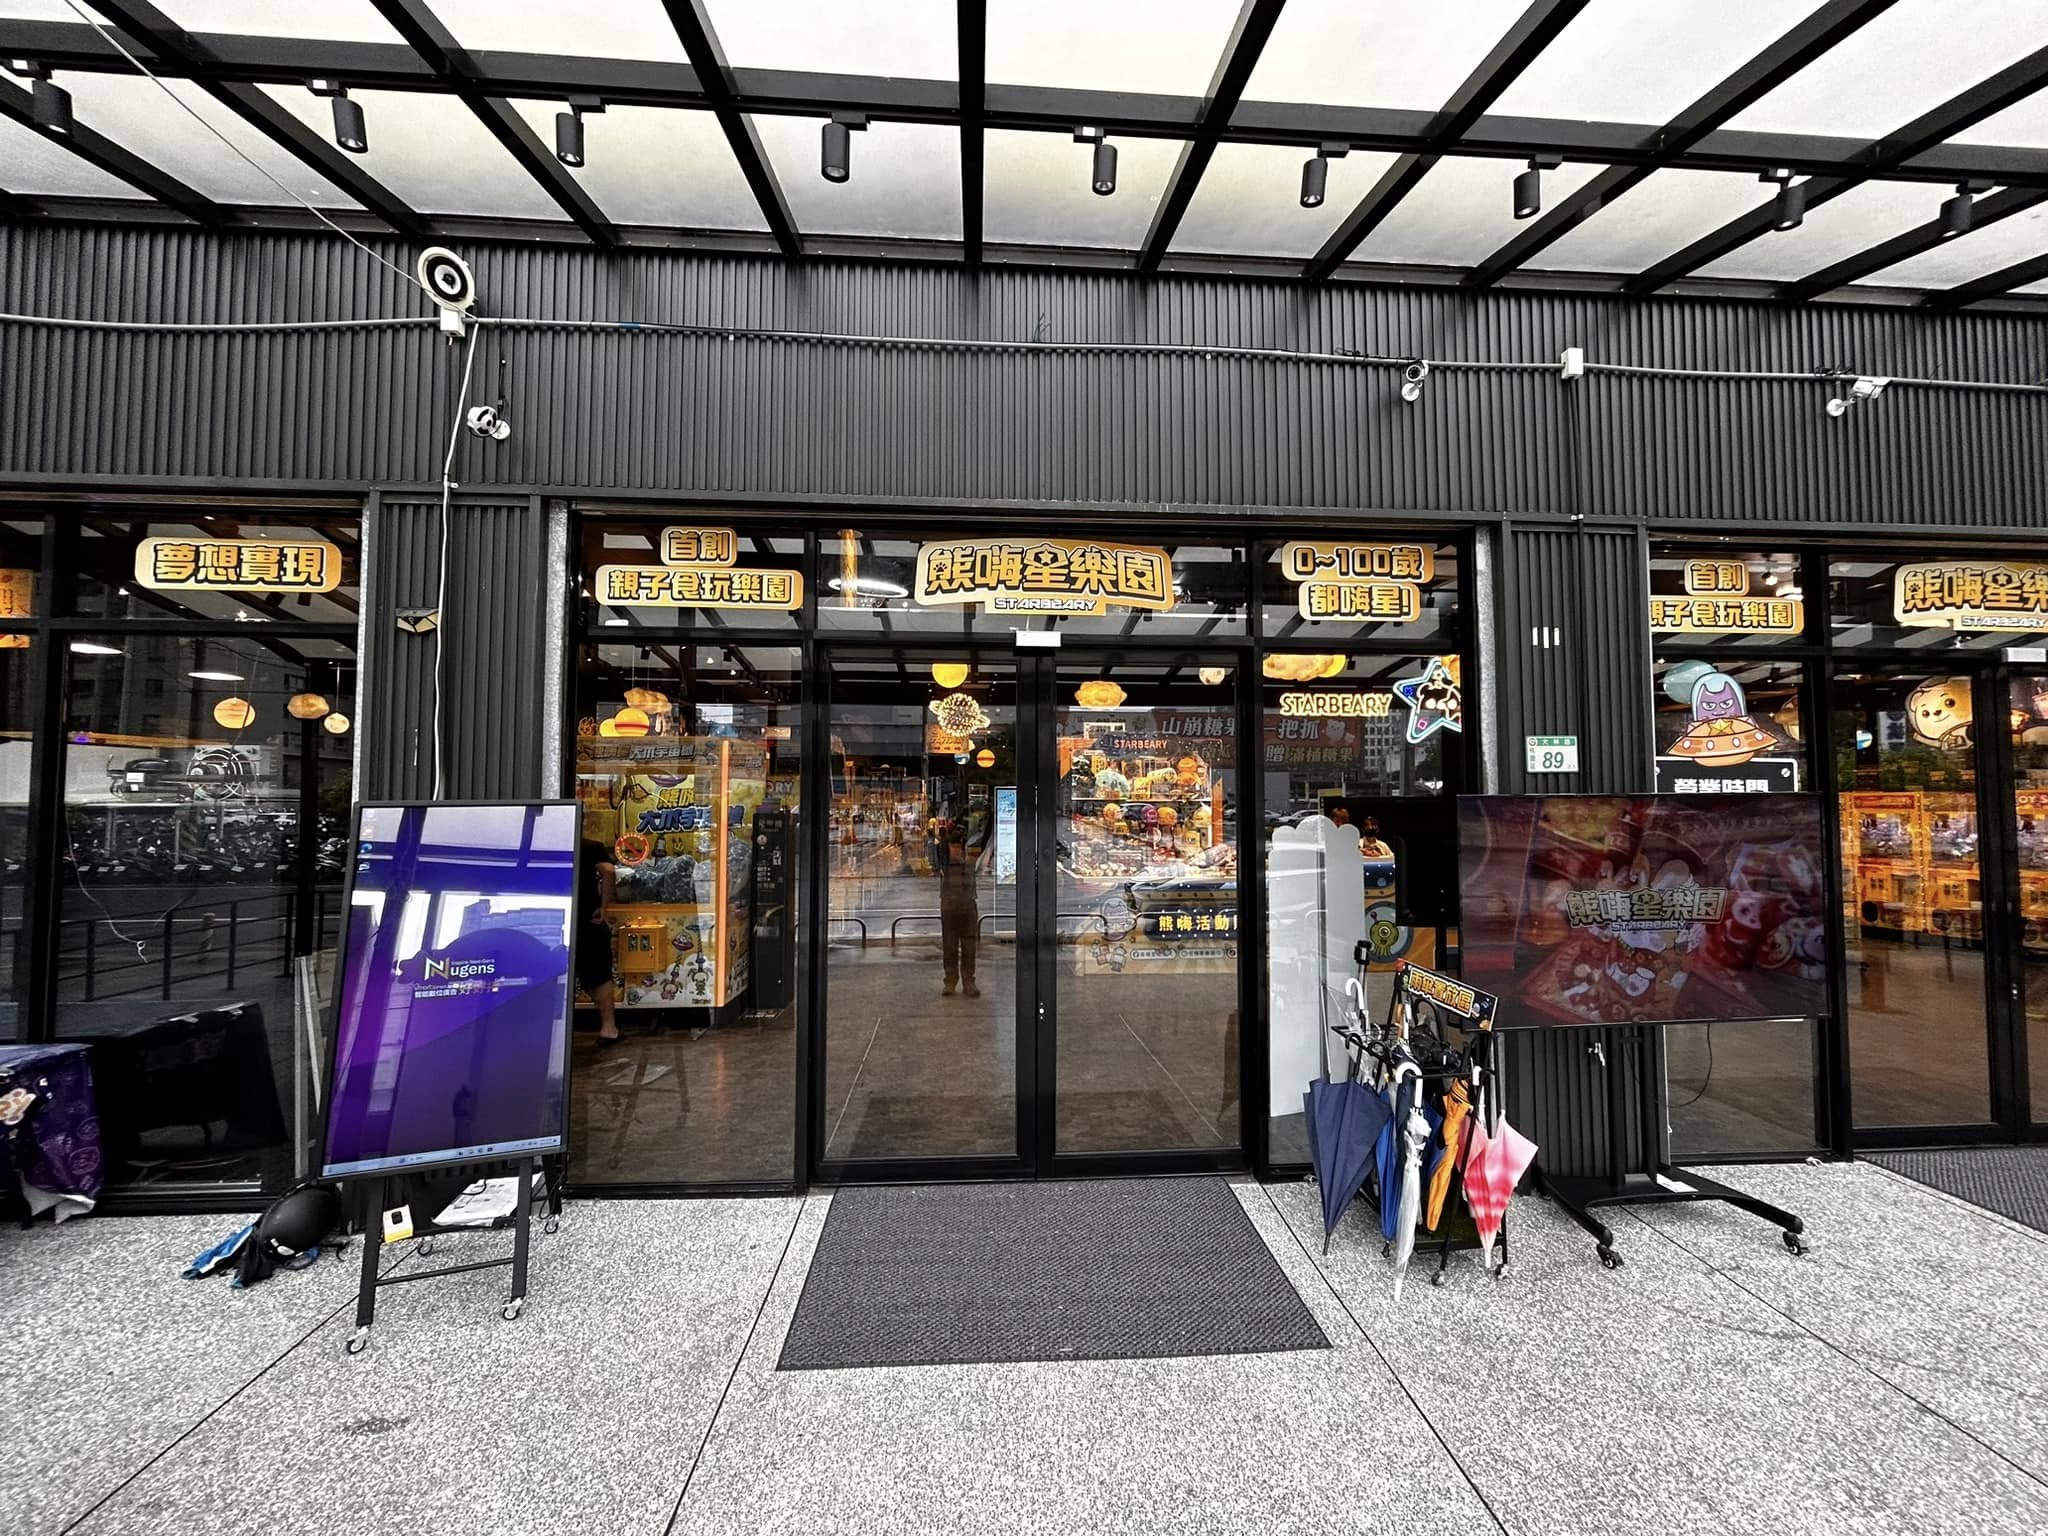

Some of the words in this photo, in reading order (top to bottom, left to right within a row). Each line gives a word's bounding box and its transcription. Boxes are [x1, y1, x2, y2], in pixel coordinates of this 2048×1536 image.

[669, 532, 730, 561] 首創
[154, 543, 325, 586] 夢想實現
[926, 544, 1164, 601] 熊嗨星樂園
[1294, 547, 1423, 578] 0~100歲
[608, 569, 792, 602] 親子食玩樂園
[1691, 563, 1744, 592] 首創
[994, 597, 1097, 612] STARBEARY
[1308, 585, 1411, 617] 都嗨星!
[1280, 692, 1393, 716] STARBEARY
[1113, 740, 1168, 750] STARBEARY
[1542, 752, 1565, 769] 89
[1567, 888, 1727, 925] 熊嗨星樂園
[424, 957, 495, 981] Nugens
